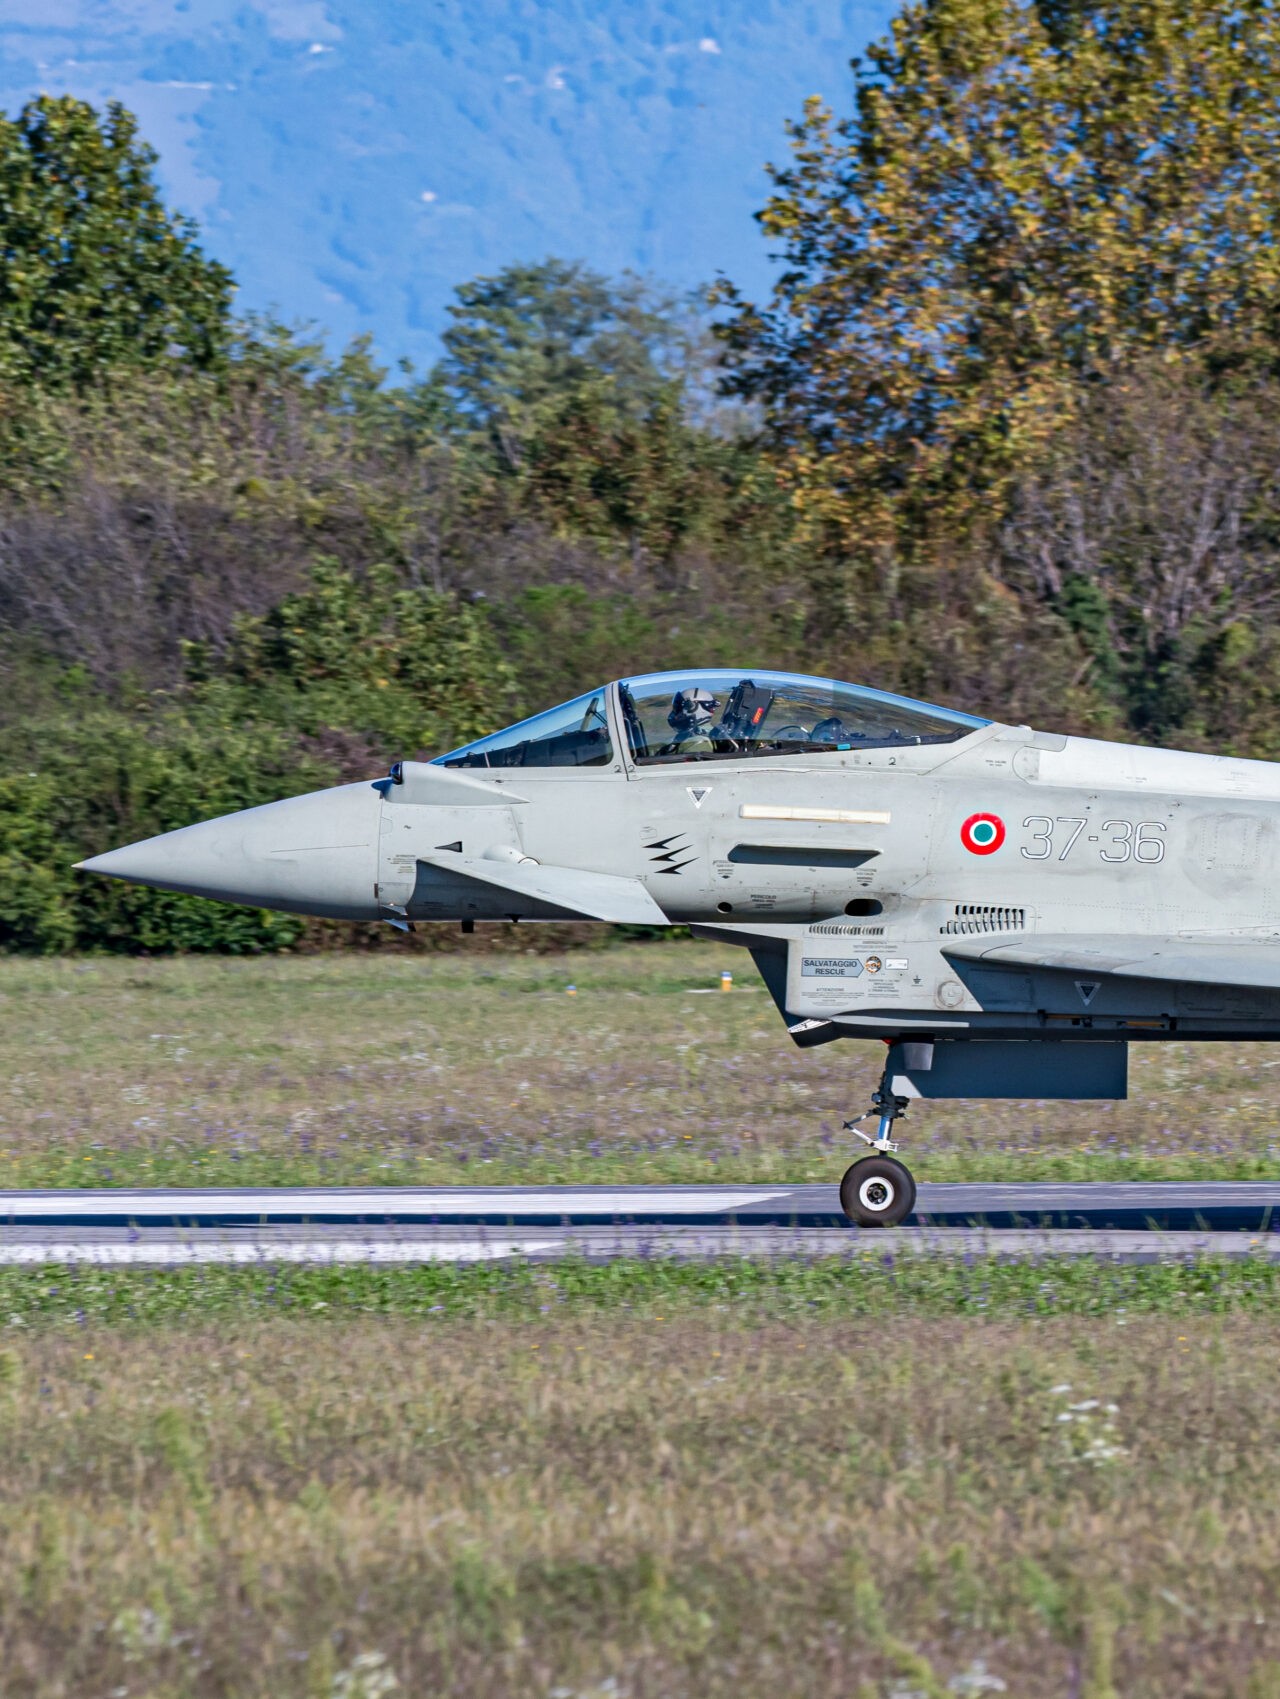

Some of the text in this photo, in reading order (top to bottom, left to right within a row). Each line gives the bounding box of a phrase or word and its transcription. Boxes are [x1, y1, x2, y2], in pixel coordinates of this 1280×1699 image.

[888, 756, 897, 766] 2
[614, 764, 622, 773] 2
[628, 764, 636, 773] 2
[1020, 815, 1167, 864] 37-36
[804, 960, 857, 968] SALVATAGGIO
